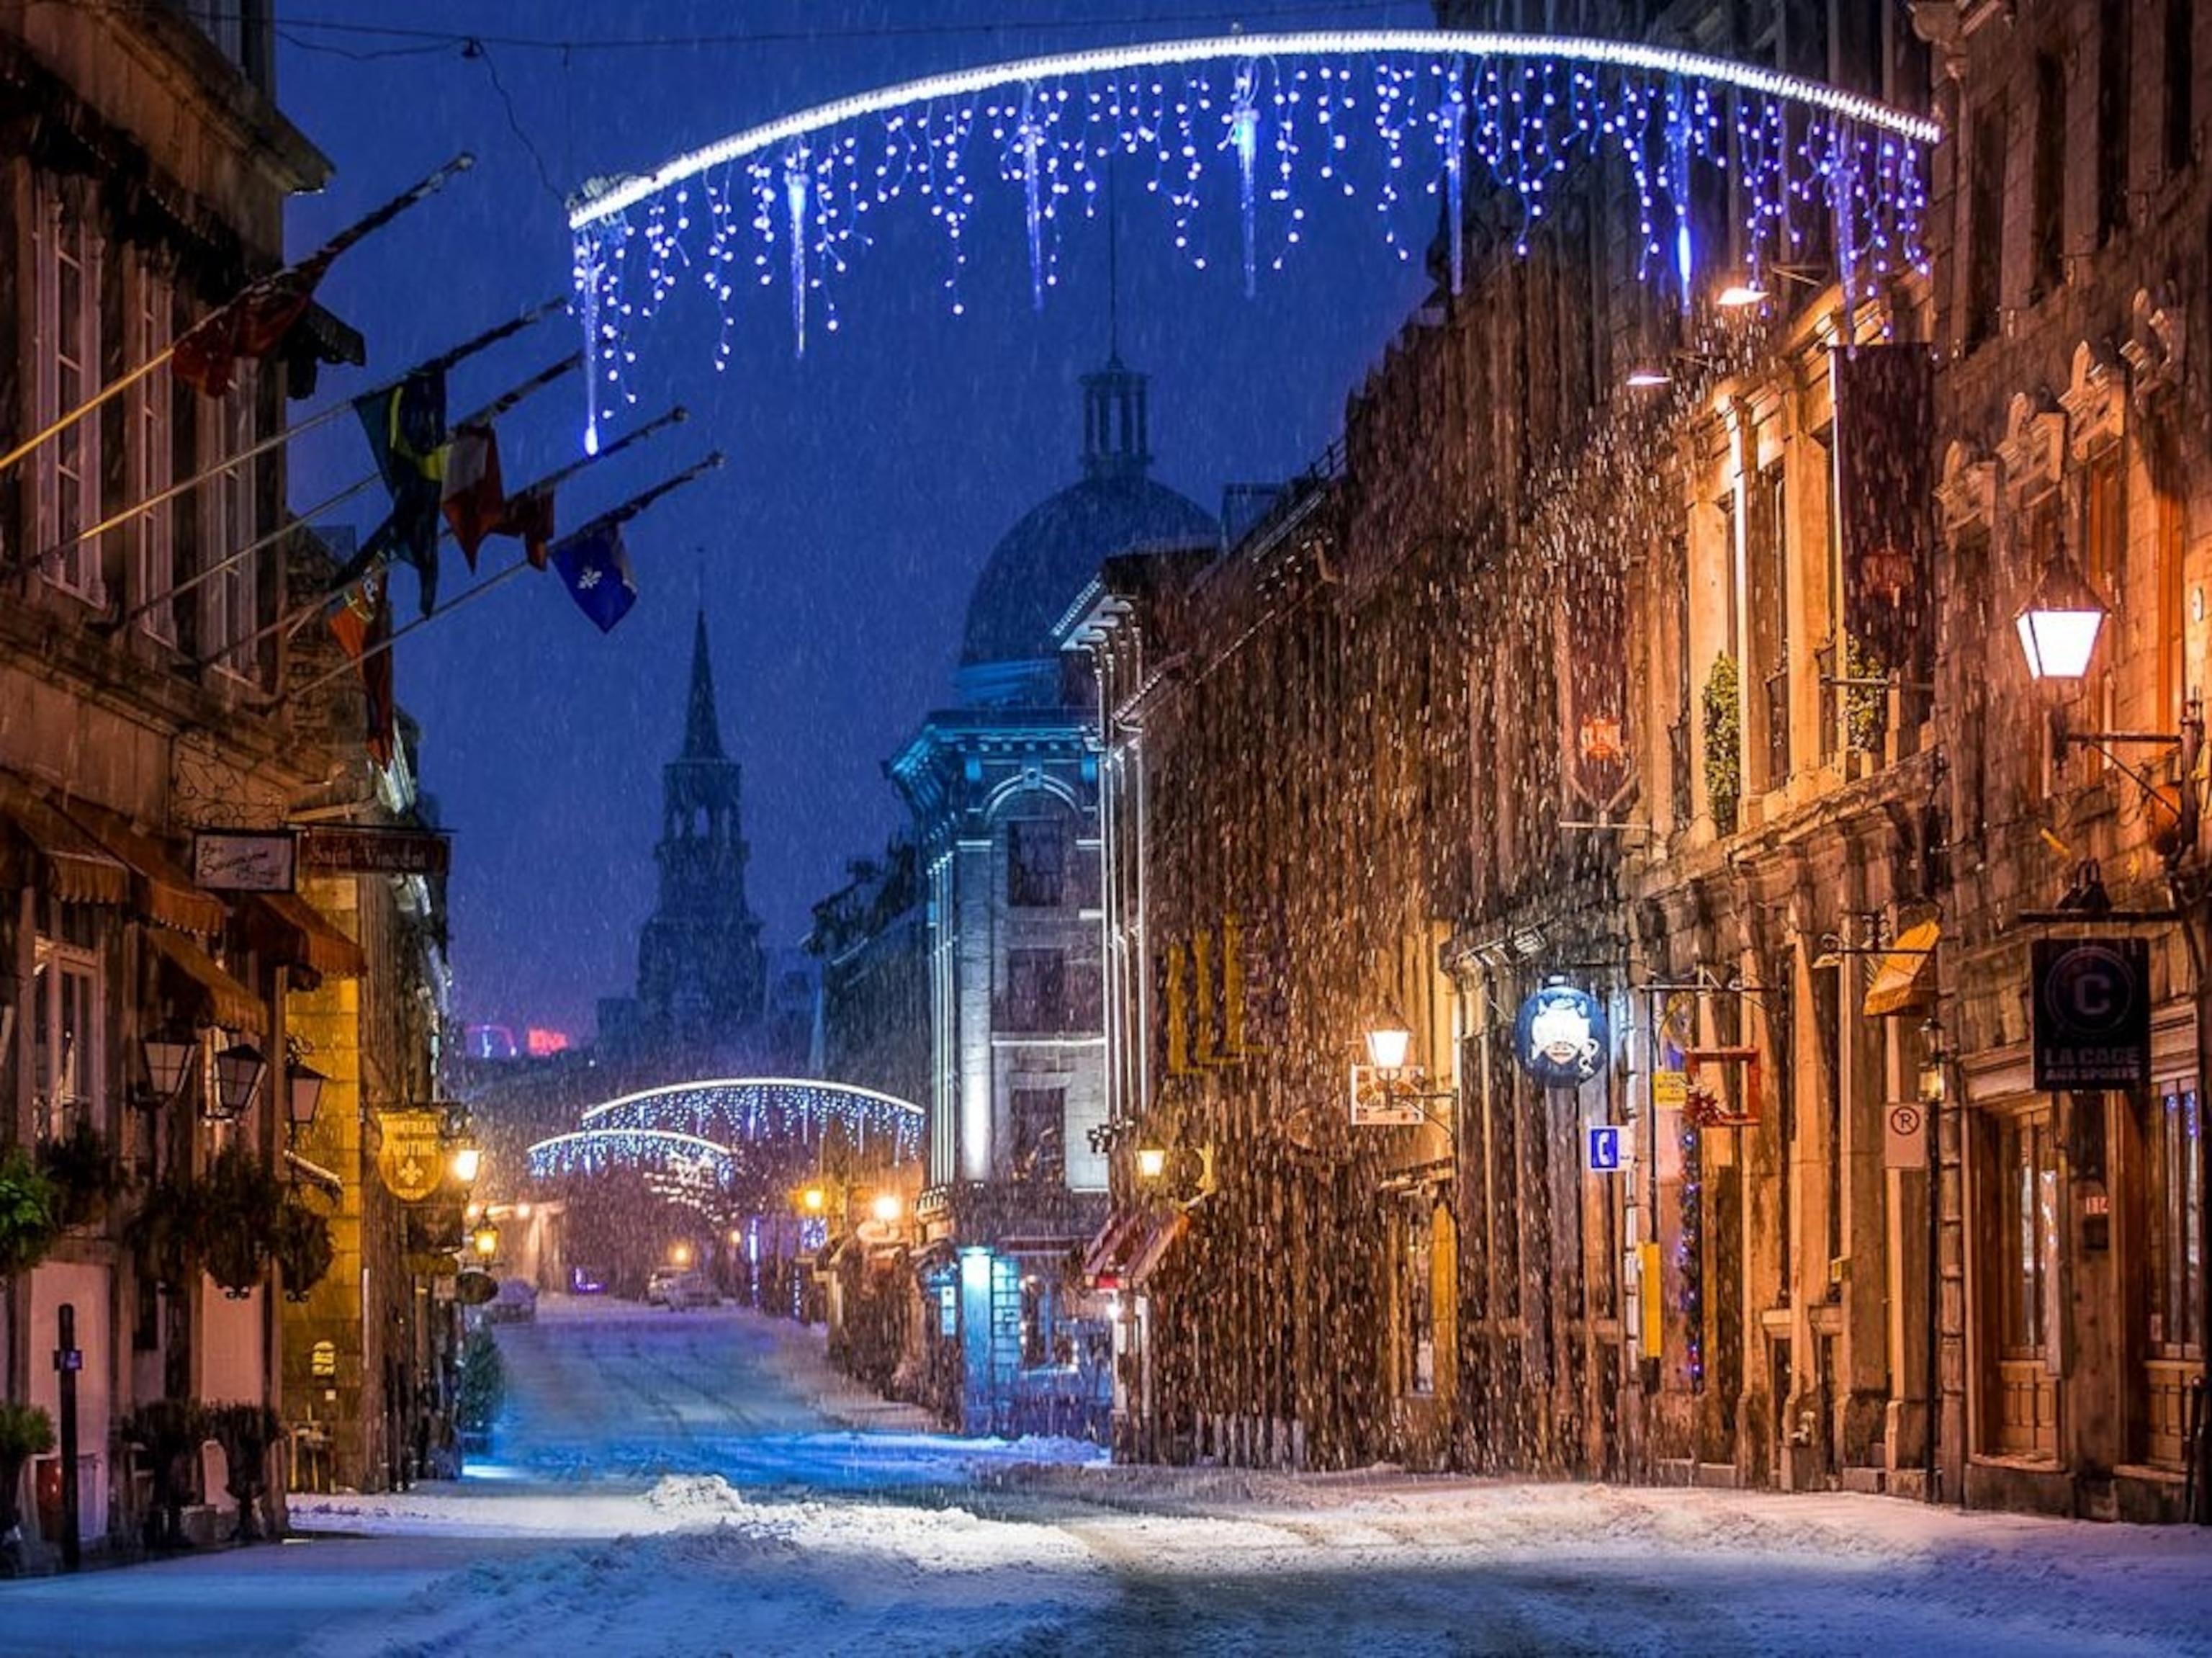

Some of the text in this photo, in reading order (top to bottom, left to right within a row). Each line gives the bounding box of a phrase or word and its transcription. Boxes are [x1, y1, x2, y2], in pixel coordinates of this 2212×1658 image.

[2074, 972, 2110, 1016] C
[2044, 1047, 2141, 1067] LA CAGE
[382, 1139, 437, 1157] POUTINE
